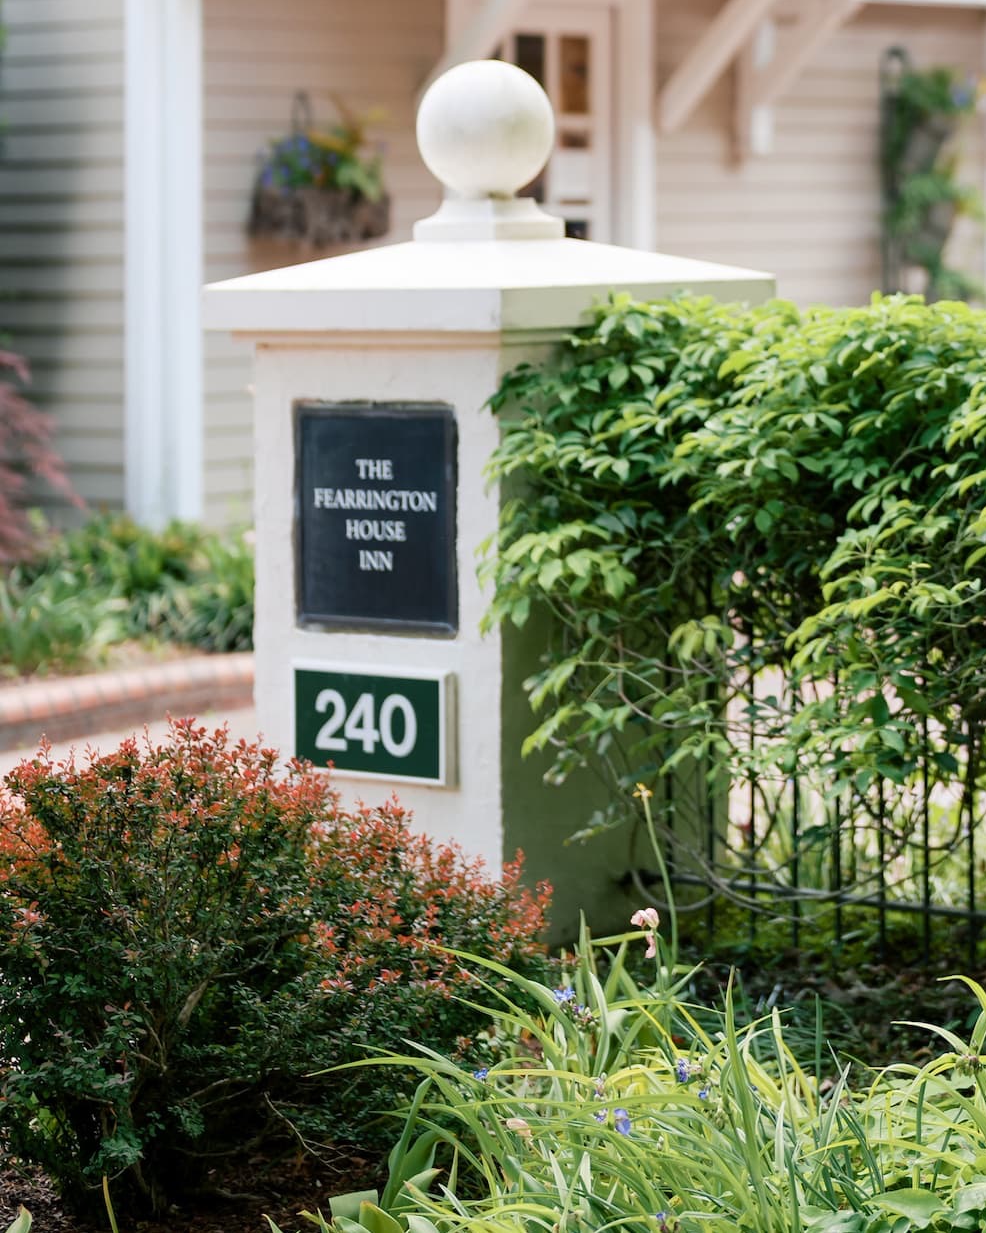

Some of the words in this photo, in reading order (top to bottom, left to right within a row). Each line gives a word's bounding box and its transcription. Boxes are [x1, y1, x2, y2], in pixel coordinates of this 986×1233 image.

[355, 459, 393, 480] THE
[313, 488, 437, 512] FEARRINGTON
[345, 519, 407, 542] HOUSE
[359, 550, 394, 571] INN
[314, 688, 417, 758] 240
